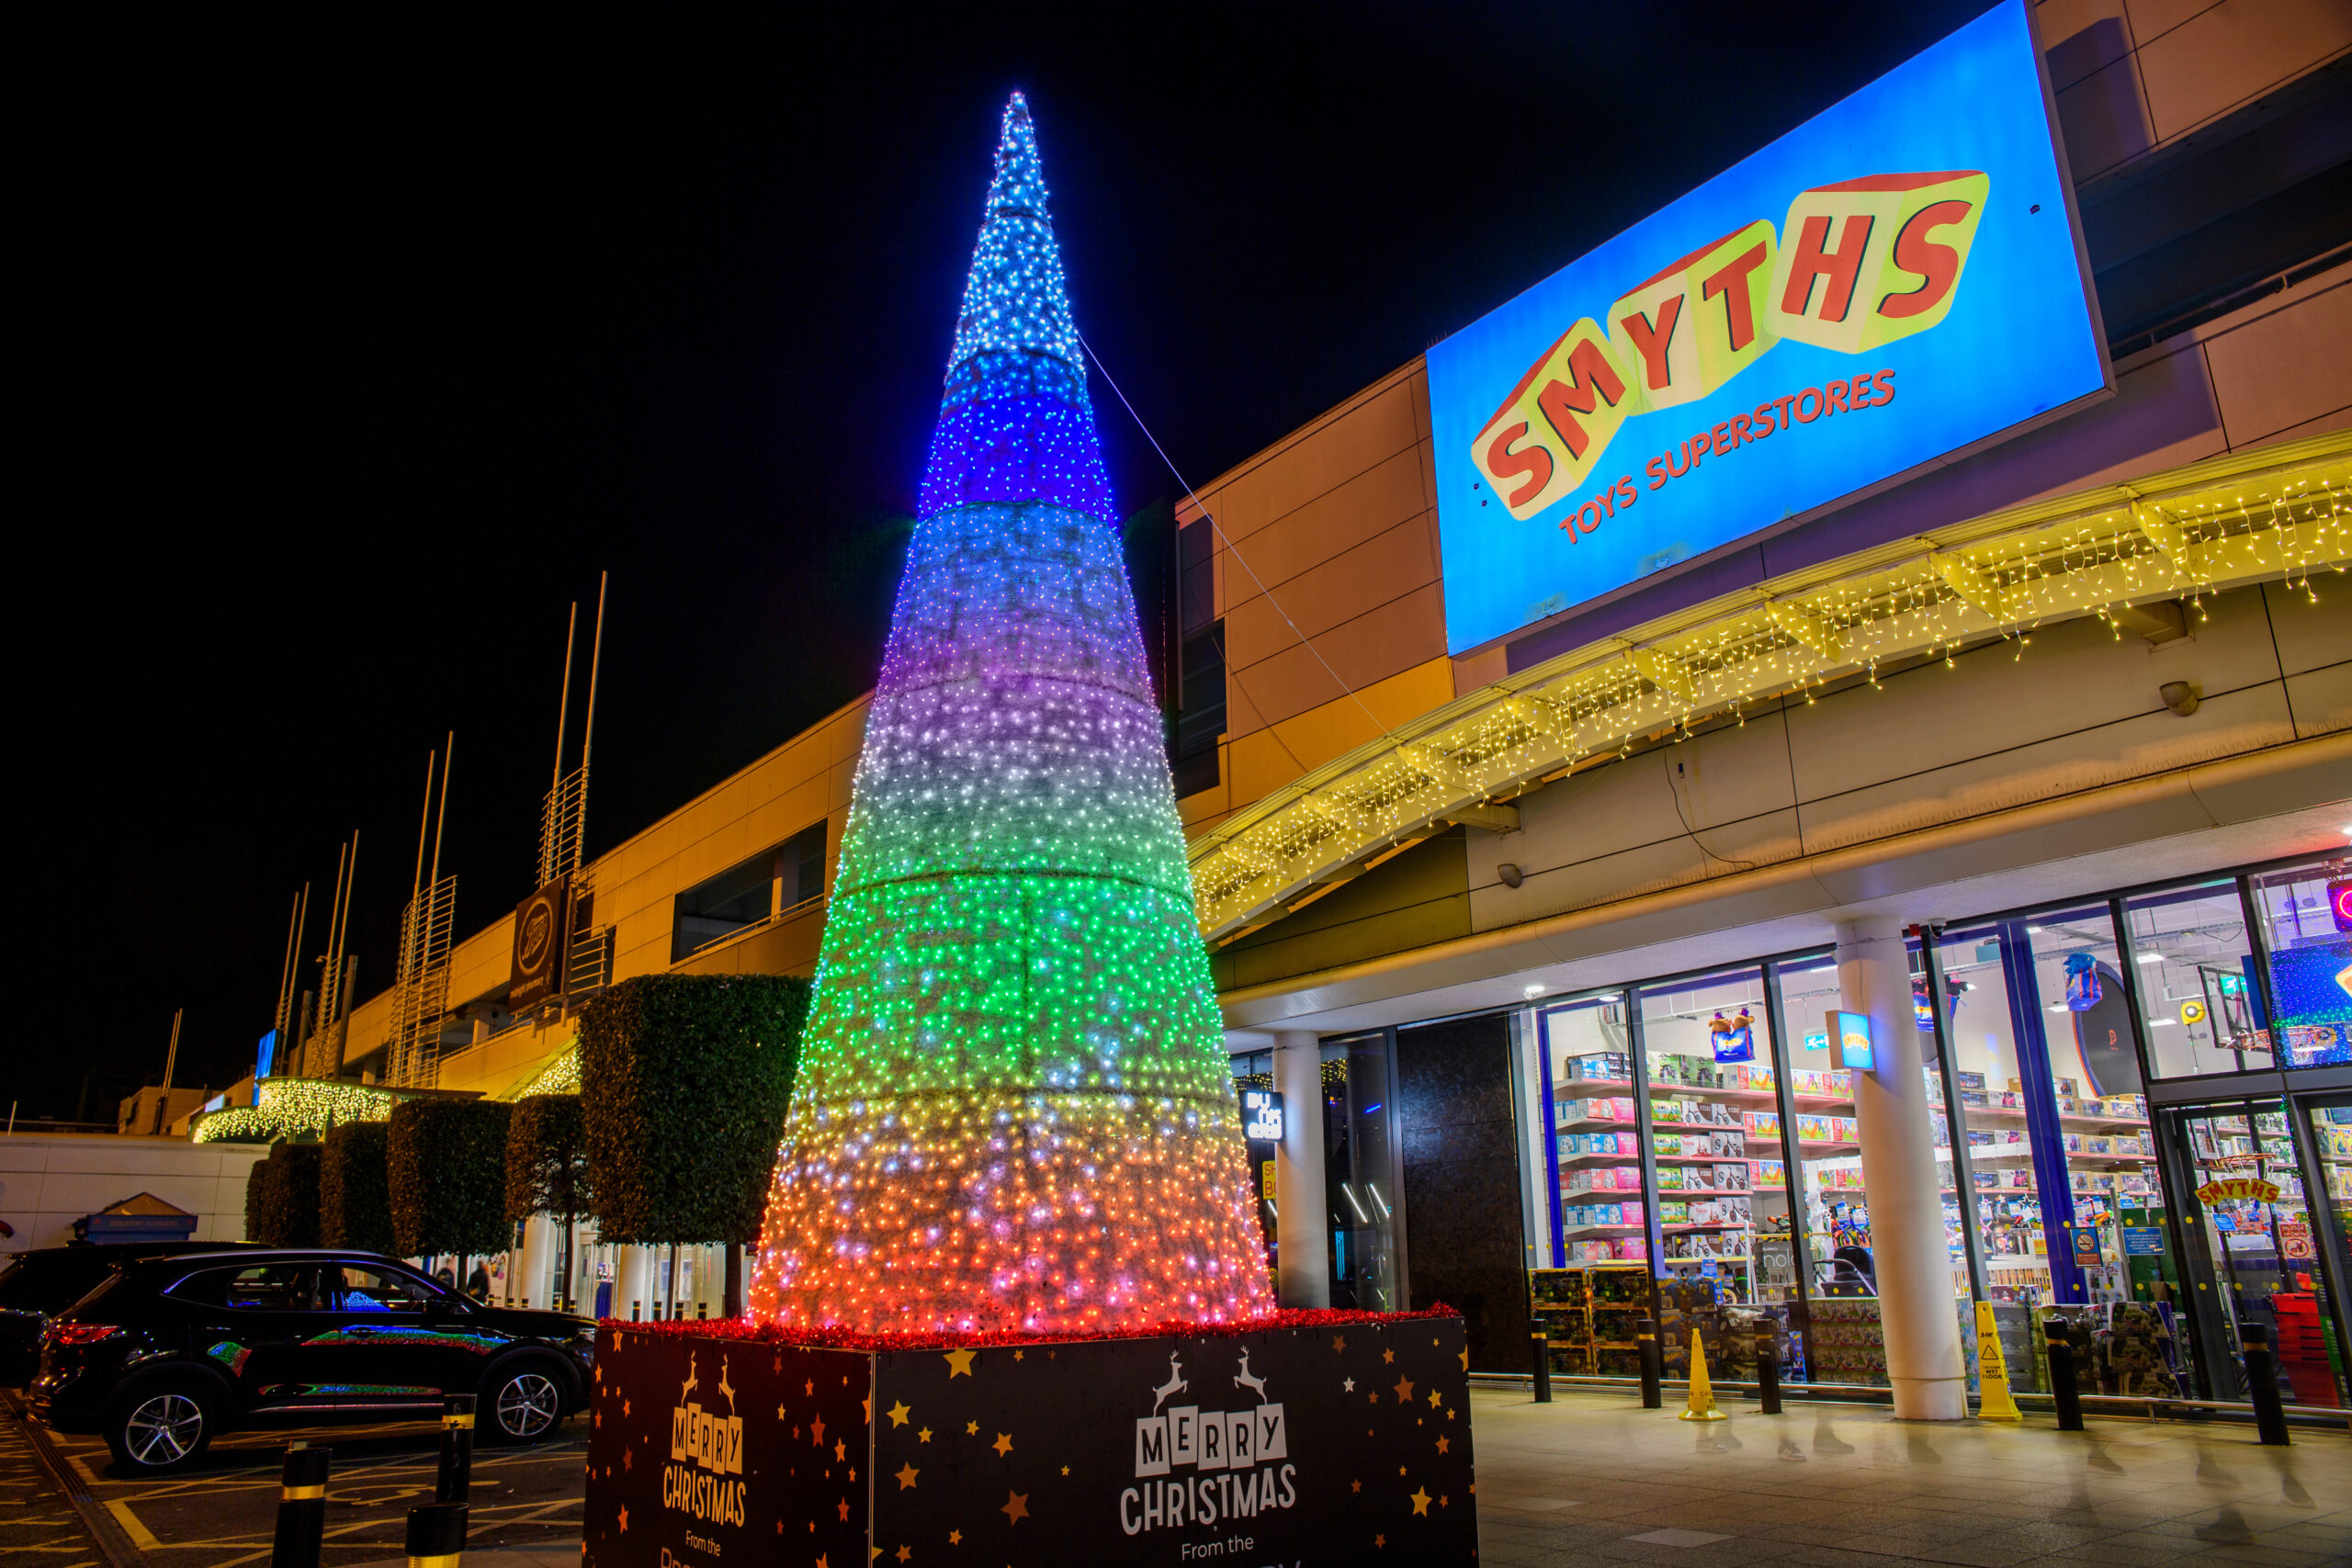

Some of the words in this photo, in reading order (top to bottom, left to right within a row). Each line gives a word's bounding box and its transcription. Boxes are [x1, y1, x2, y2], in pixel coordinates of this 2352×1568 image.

[1487, 199, 1973, 509] SMYTHS
[1558, 474, 1638, 545] TOYS
[1645, 368, 1895, 491] SUPERSTORES
[2198, 1181, 2278, 1204] SMYTHS
[674, 1411, 741, 1464] MERRY
[1141, 1415, 1280, 1465] MERRY
[663, 1465, 746, 1528] CHRISTMAS
[1120, 1463, 1296, 1536] CHRISTMAS
[685, 1530, 707, 1551] From
[707, 1538, 721, 1557] the
[1182, 1540, 1224, 1562] From
[1227, 1535, 1254, 1553] the
